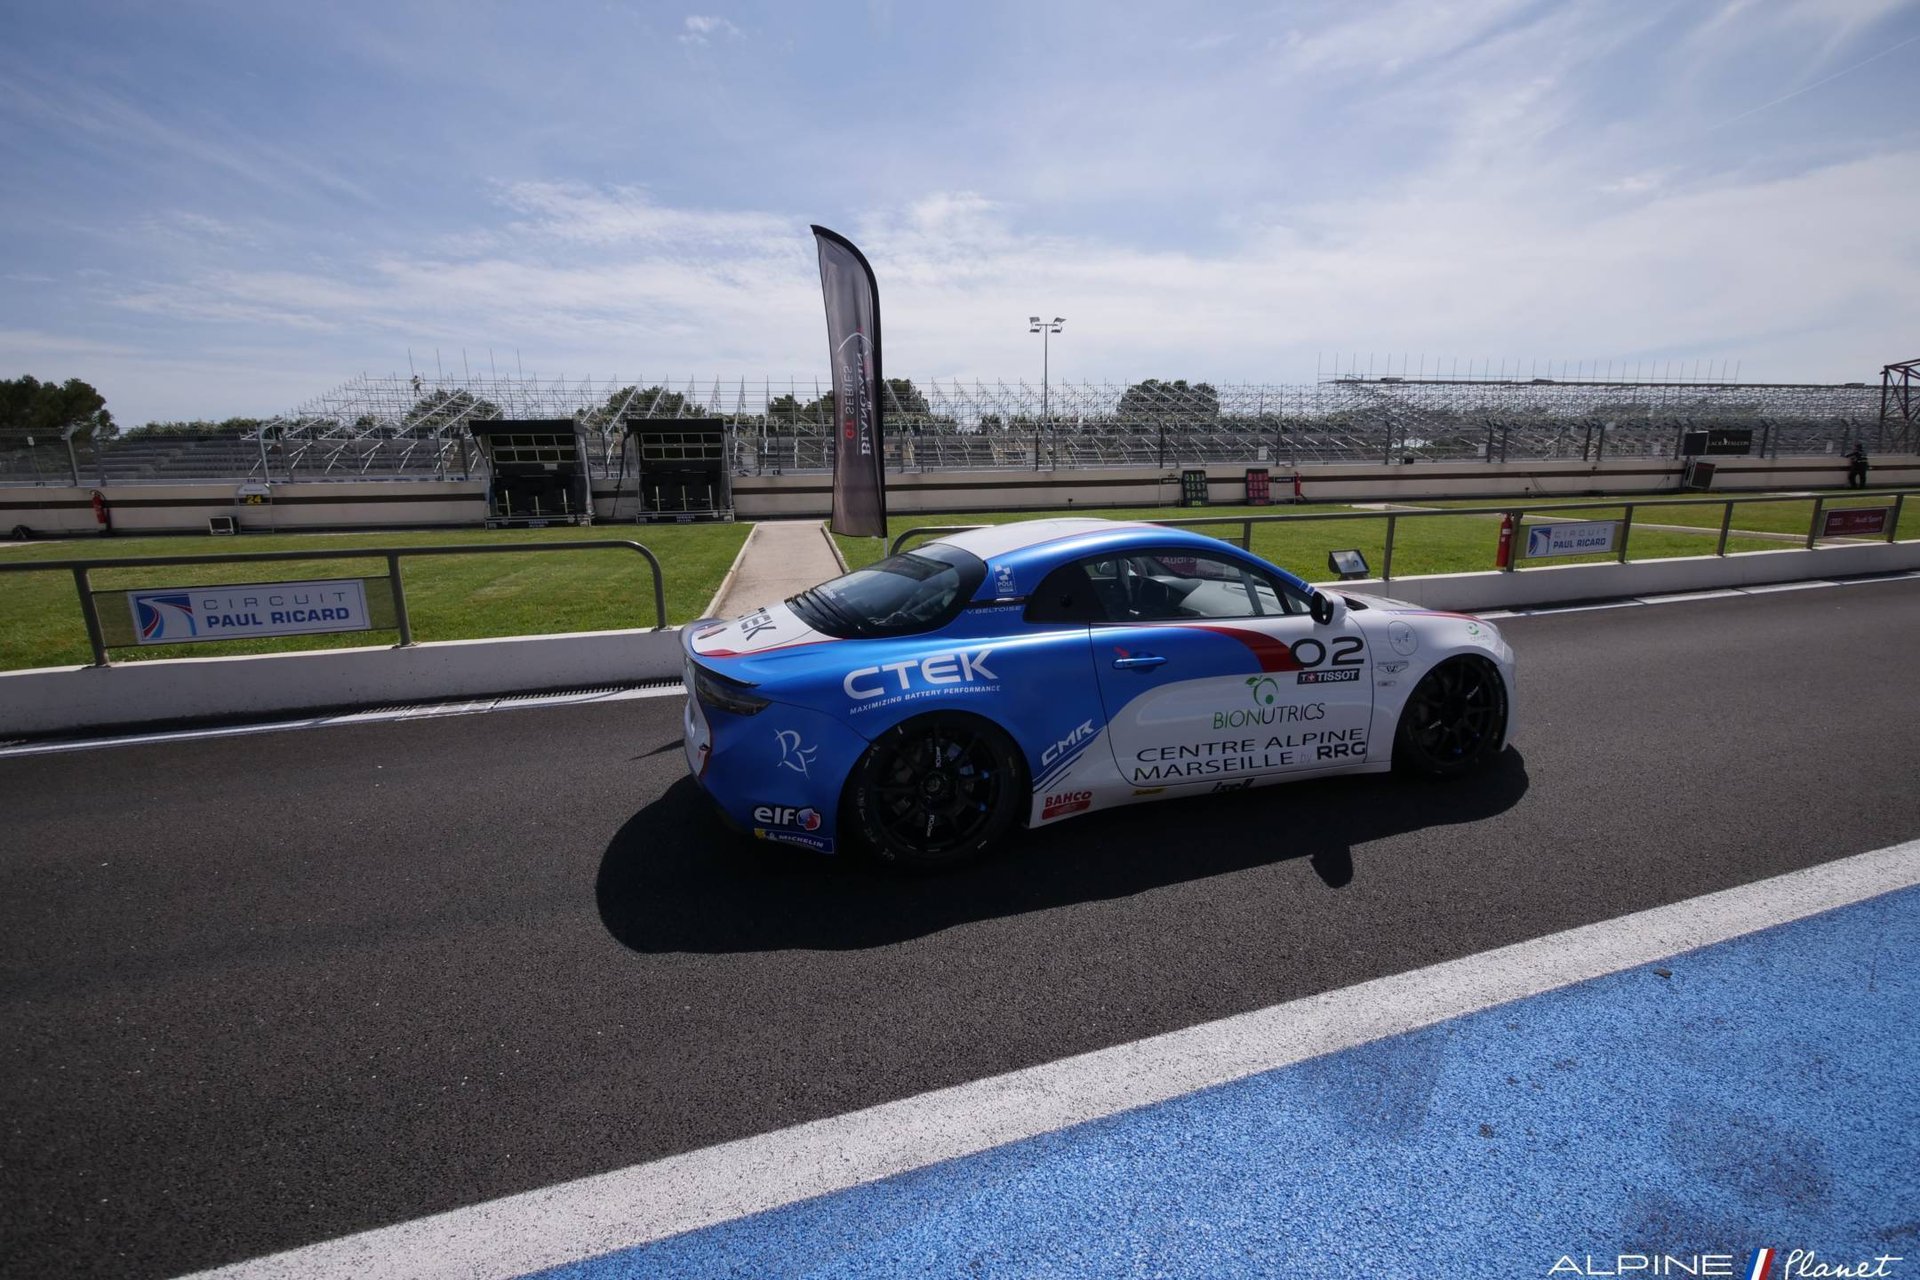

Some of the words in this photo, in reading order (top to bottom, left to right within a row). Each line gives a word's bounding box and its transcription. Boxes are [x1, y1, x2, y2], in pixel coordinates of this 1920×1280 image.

[1553, 540, 1574, 549] PAUL
[1576, 537, 1606, 547] RICARD
[203, 592, 346, 610] CIRCUIT
[206, 612, 263, 628] PAUL
[270, 607, 350, 625] RICARD
[843, 649, 999, 700] CTEK
[1318, 670, 1358, 682] TISSOT
[849, 695, 903, 715] MAXIMIZING
[904, 689, 941, 701] BATTERY
[943, 685, 1001, 695] PERFORMANCE
[1212, 702, 1326, 730] BIONUTRICS
[1041, 719, 1095, 767] CMR
[1136, 738, 1256, 763] CENTRE
[1264, 727, 1364, 749] ALPINE
[1133, 751, 1294, 781] MARSEILLE
[1316, 741, 1367, 761] RRG
[1045, 791, 1093, 808] BAHCO
[753, 806, 796, 825] elf
[778, 834, 824, 848] MICHELIN
